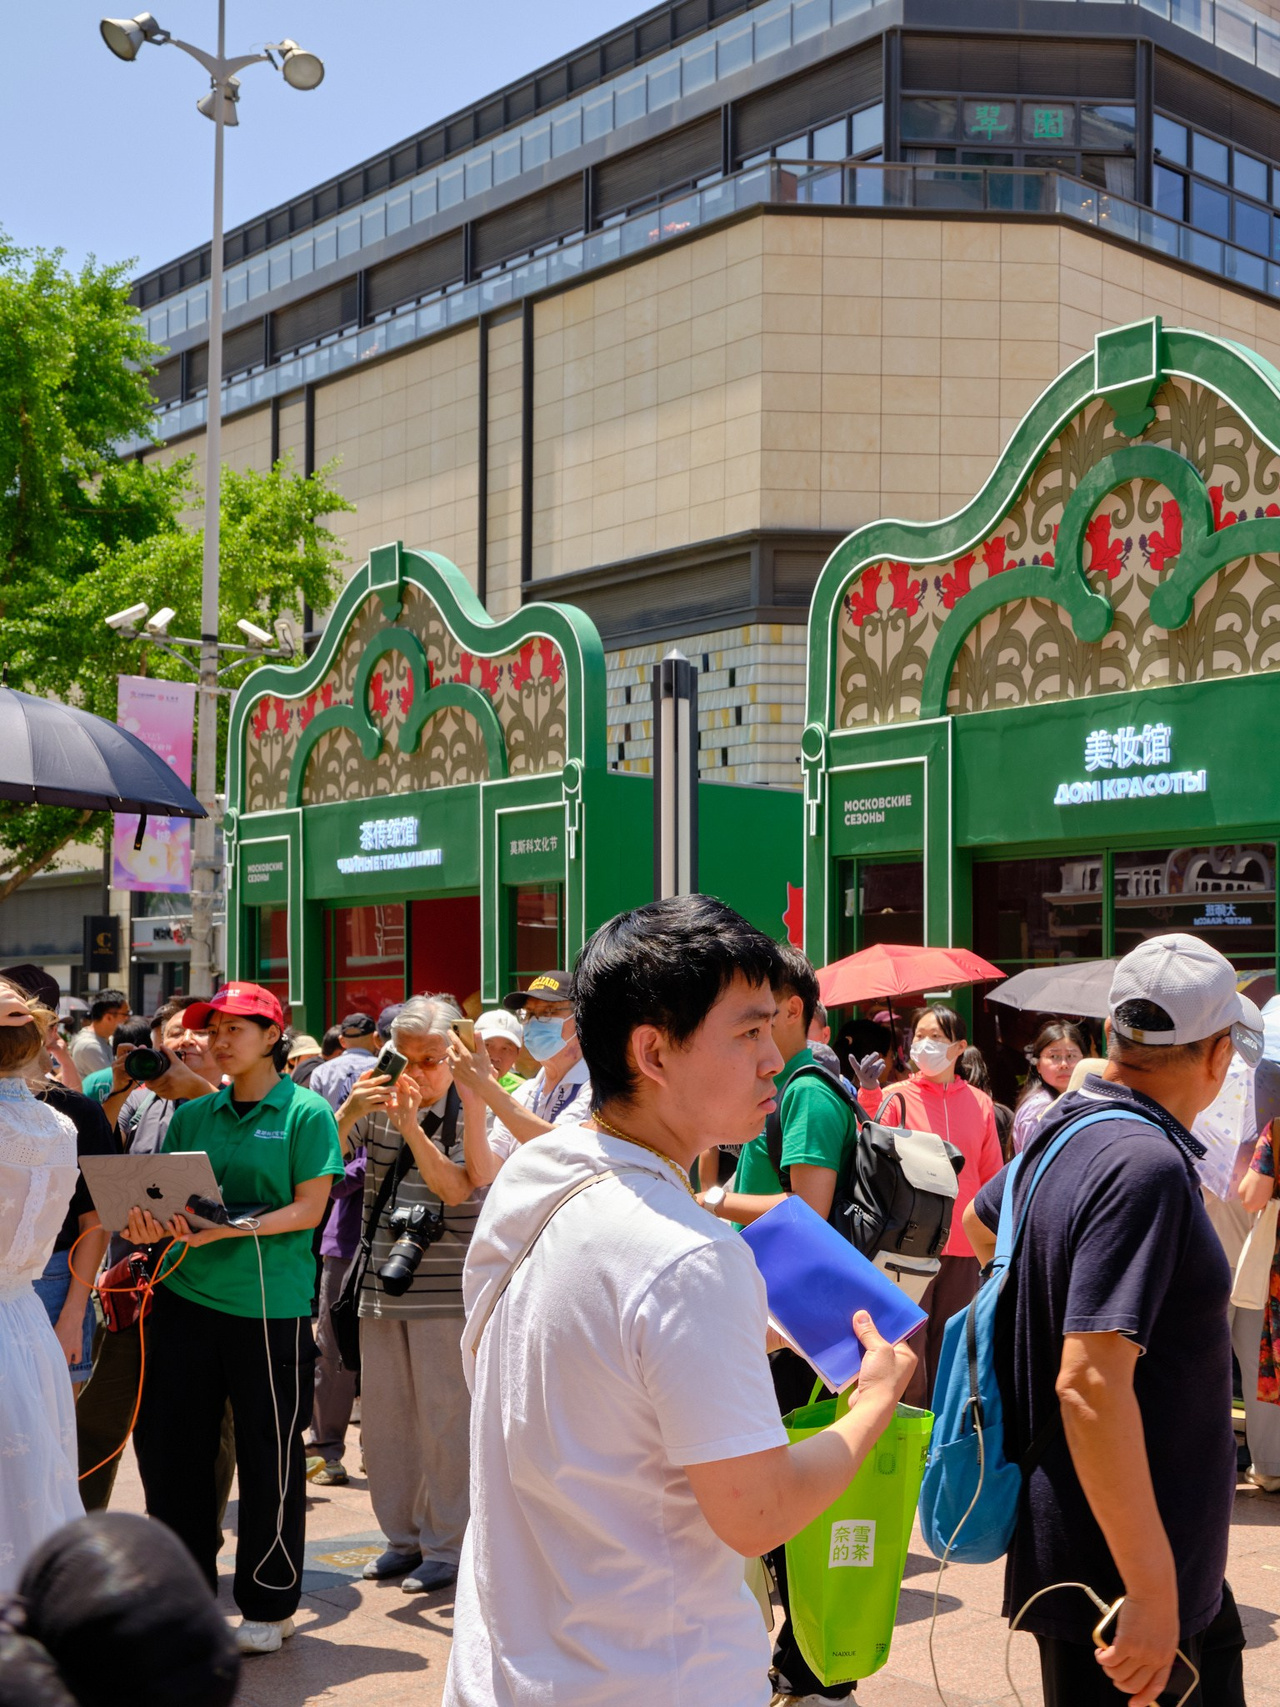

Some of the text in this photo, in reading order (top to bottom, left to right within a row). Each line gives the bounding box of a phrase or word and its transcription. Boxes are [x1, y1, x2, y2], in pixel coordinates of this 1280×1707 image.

[1085, 722, 1172, 772] 美妆馆
[1053, 769, 1206, 805] ДОМ КРАСОТЫ
[844, 794, 912, 812] МОСКОВСКИЕ
[844, 811, 885, 826] СЕЗОНЫ
[510, 836, 558, 855] 莫斯科文化节
[832, 1543, 870, 1562] 的茶
